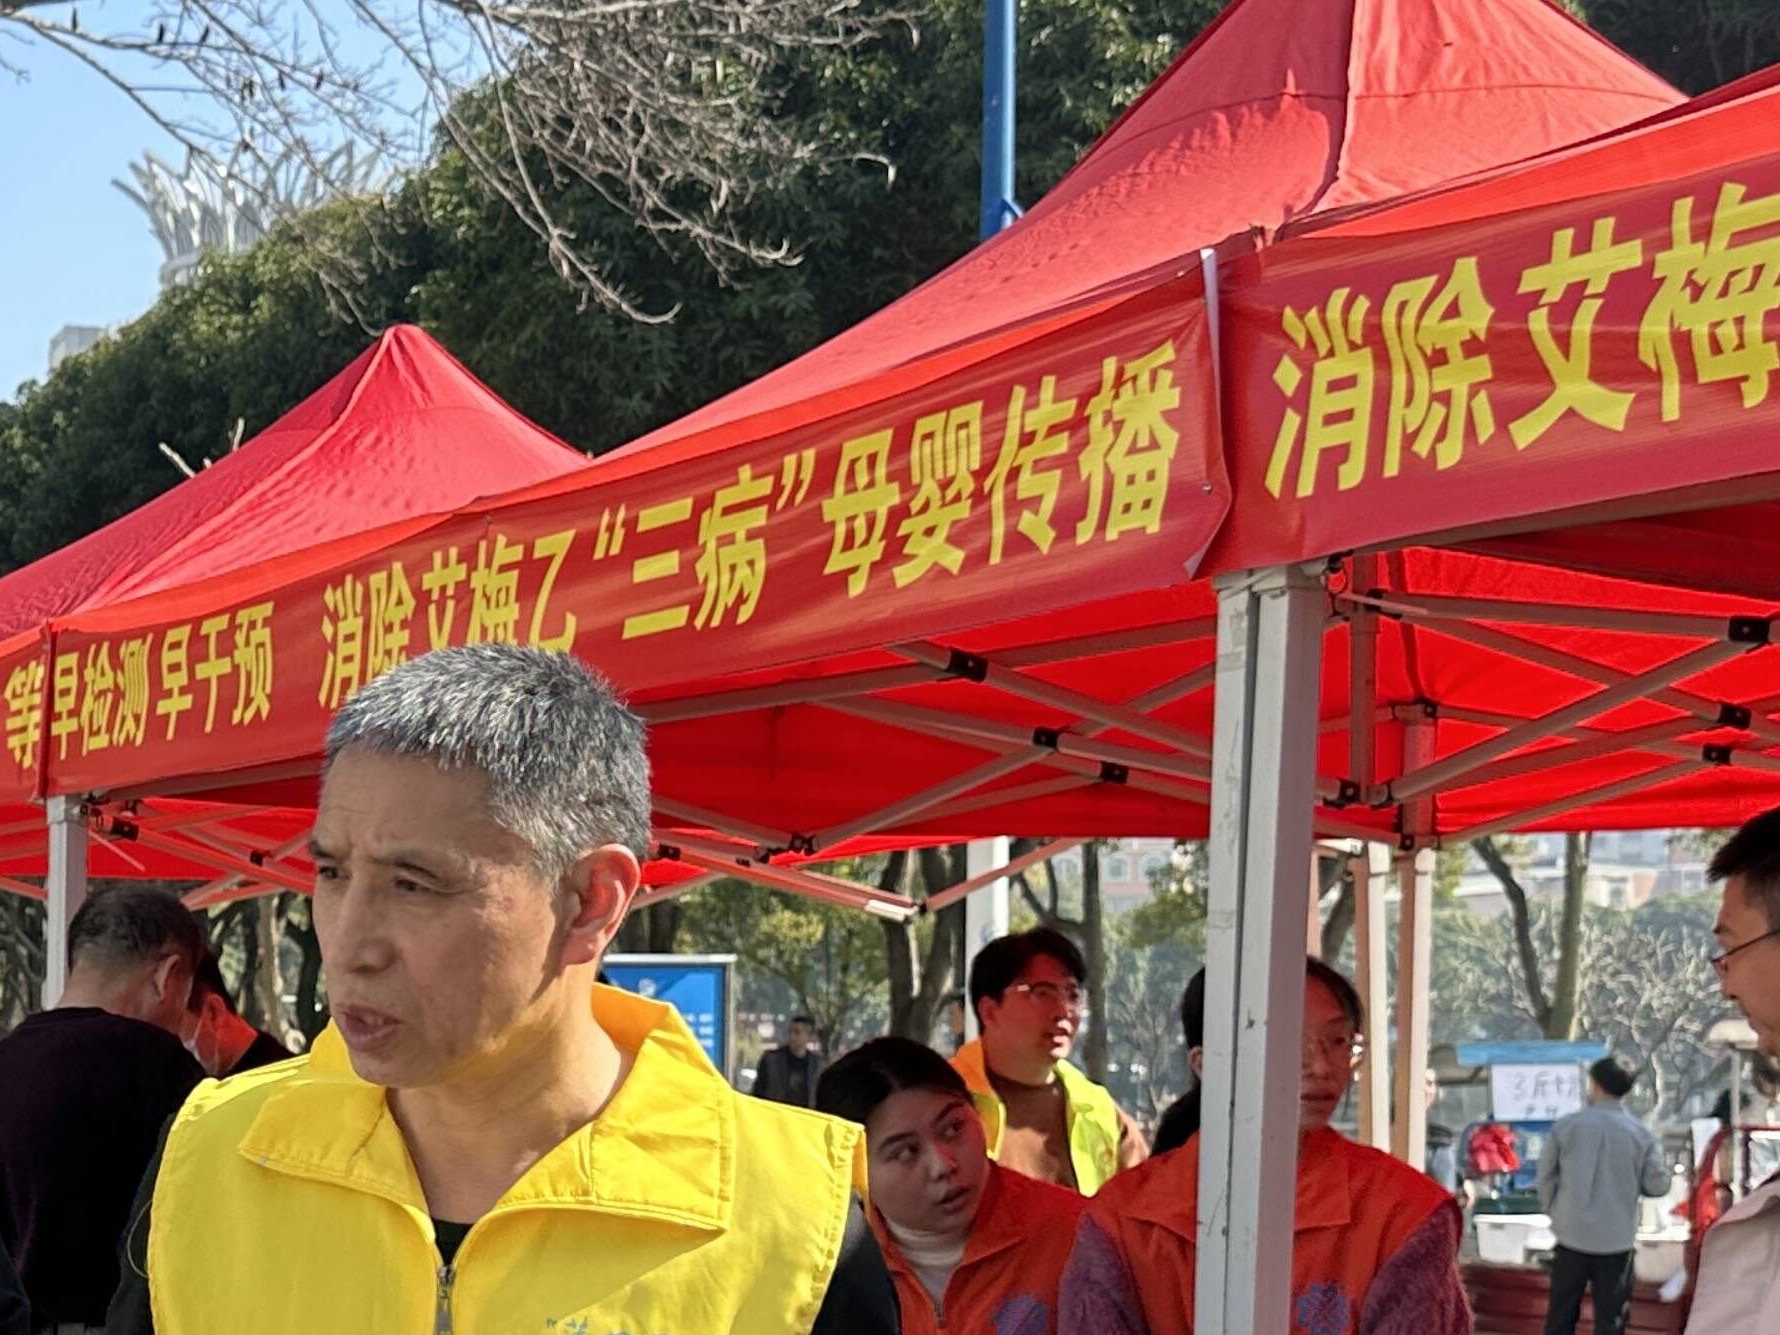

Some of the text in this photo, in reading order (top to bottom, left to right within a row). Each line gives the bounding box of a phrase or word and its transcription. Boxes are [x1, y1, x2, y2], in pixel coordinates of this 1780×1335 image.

[1264, 182, 1780, 499] 消除艾梅
[49, 602, 275, 761] 早检测早干预
